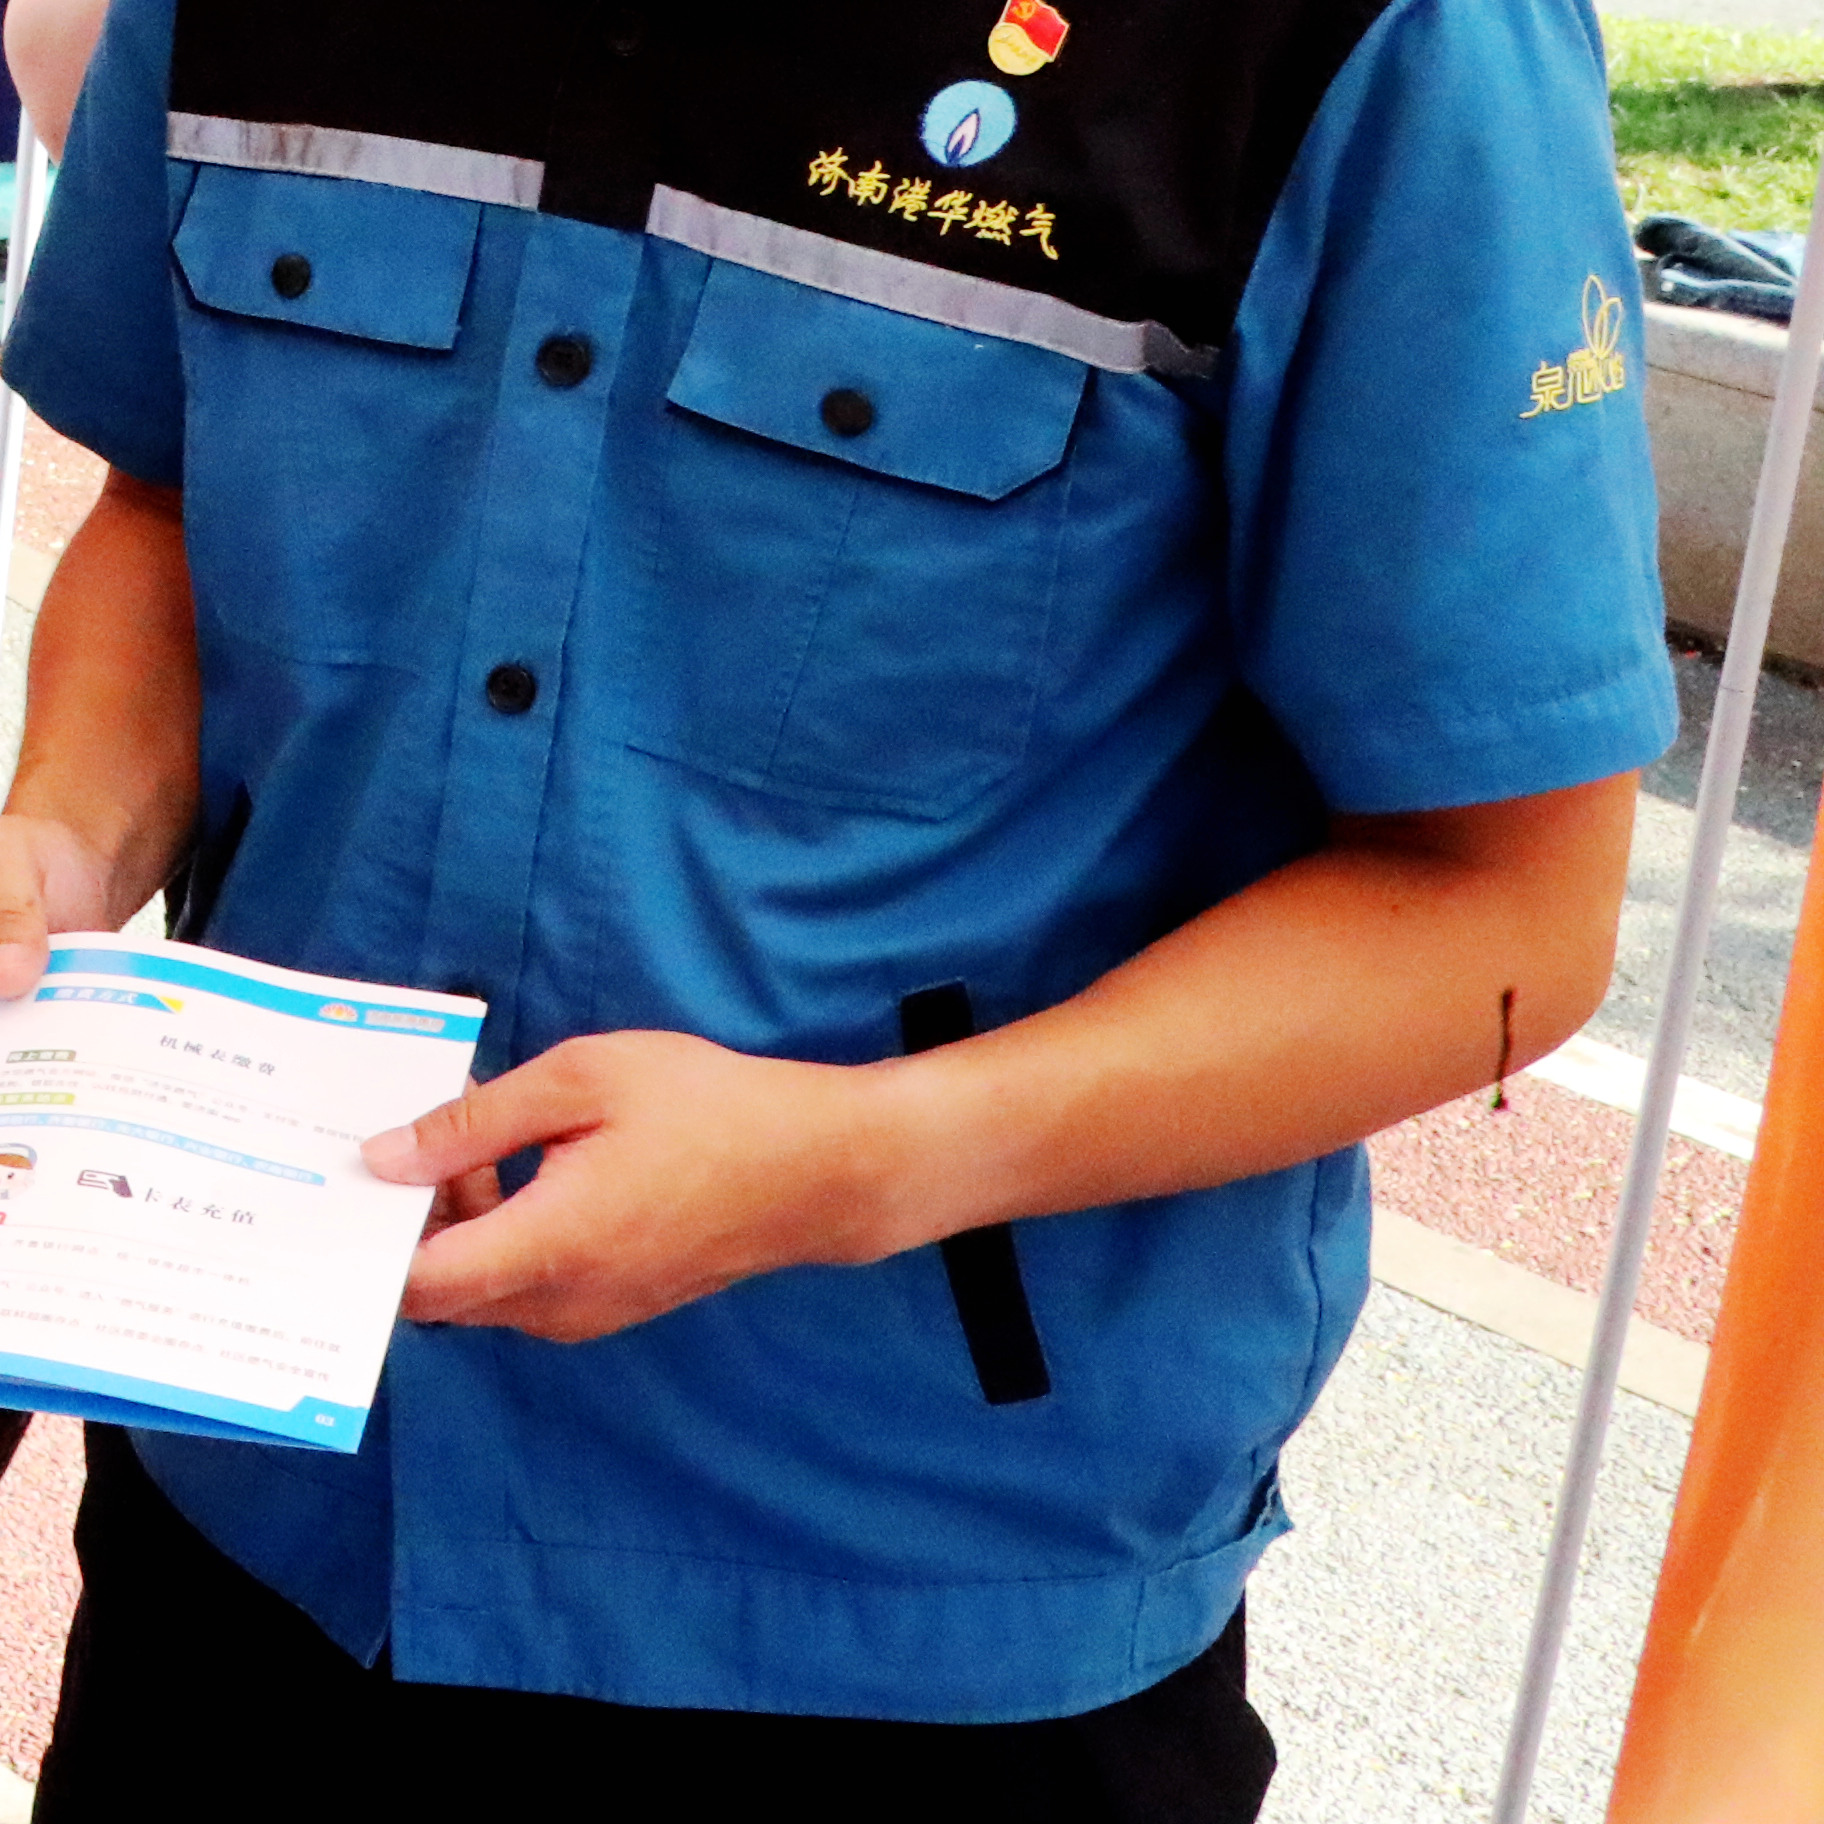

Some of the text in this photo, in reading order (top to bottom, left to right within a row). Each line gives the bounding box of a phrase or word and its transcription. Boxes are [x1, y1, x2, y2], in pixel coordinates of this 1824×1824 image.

[808, 147, 1059, 260] 济南港华燃气
